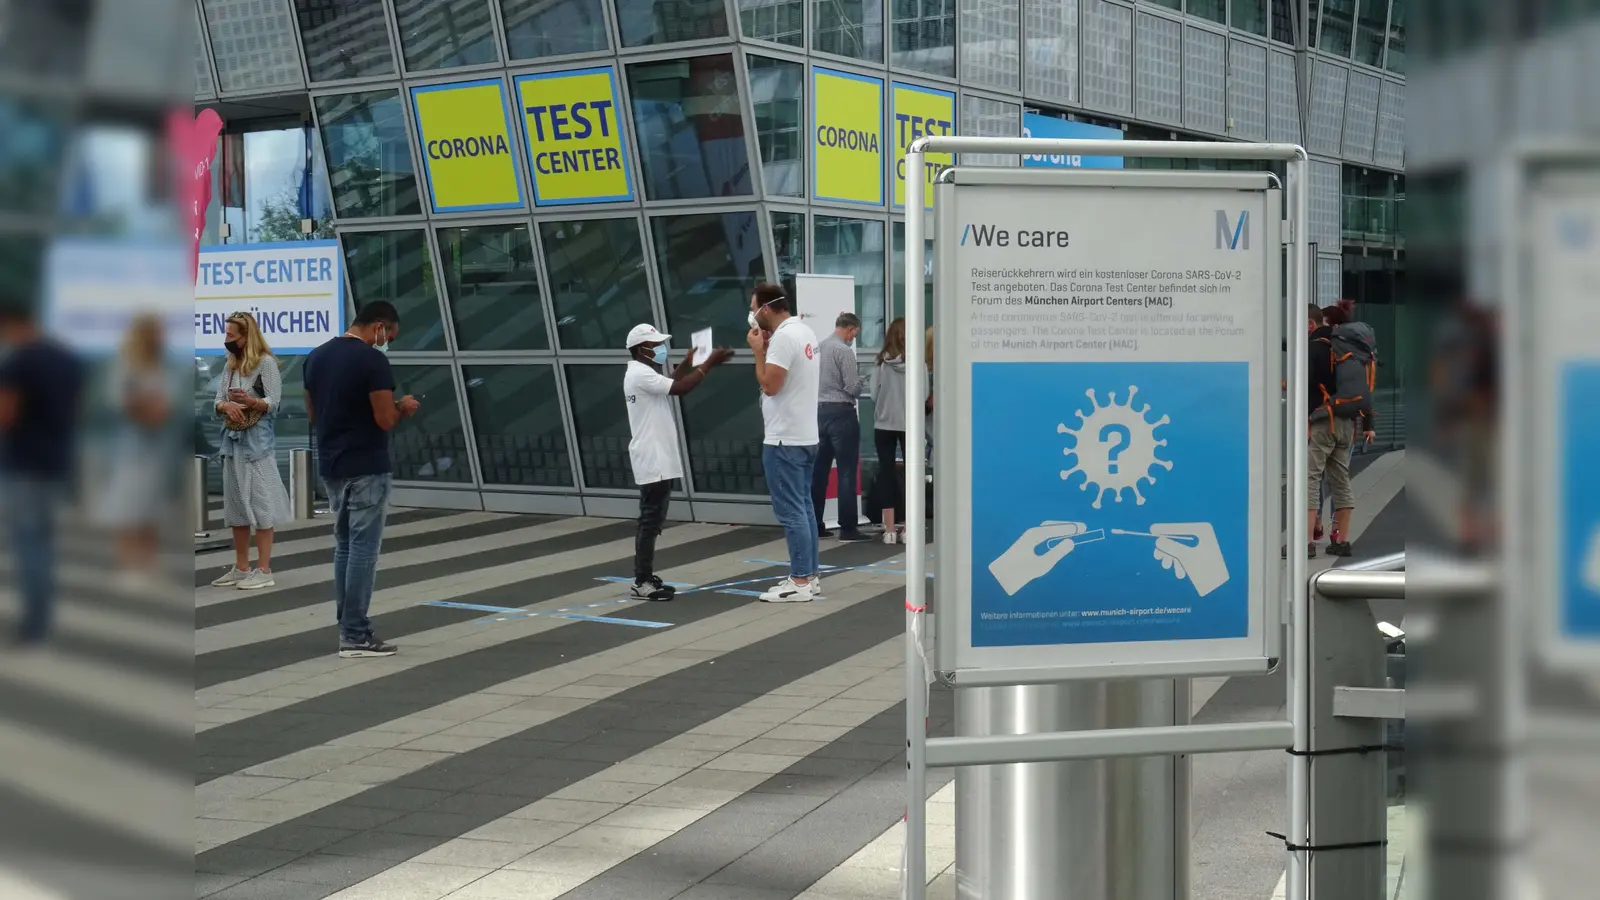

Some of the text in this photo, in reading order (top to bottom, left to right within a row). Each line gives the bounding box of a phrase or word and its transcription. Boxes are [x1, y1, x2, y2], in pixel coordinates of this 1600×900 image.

[526, 99, 612, 142] TEST
[427, 133, 509, 160] CORONA
[817, 124, 879, 154] CORONA
[535, 146, 621, 175] CENTER
[1017, 230, 1069, 248] care
[199, 256, 332, 286] TEST-CENTER
[971, 268, 1242, 280] Reiserückkehrern wird ein kostenloser Corona SARS-CoV-2
[971, 282, 1231, 294] Test angeboten. Das Corona Test Center befindet sich im
[971, 295, 1003, 305] Forum
[1005, 295, 1022, 305] des
[1025, 295, 1069, 306] München
[1071, 296, 1104, 307] Airport
[1106, 296, 1143, 306] Centers
[1002, 339, 1038, 349] Munich
[1040, 339, 1073, 351] Airport
[1075, 339, 1107, 349] Center
[1081, 606, 1192, 617] www.munich-airport.de/wecare
